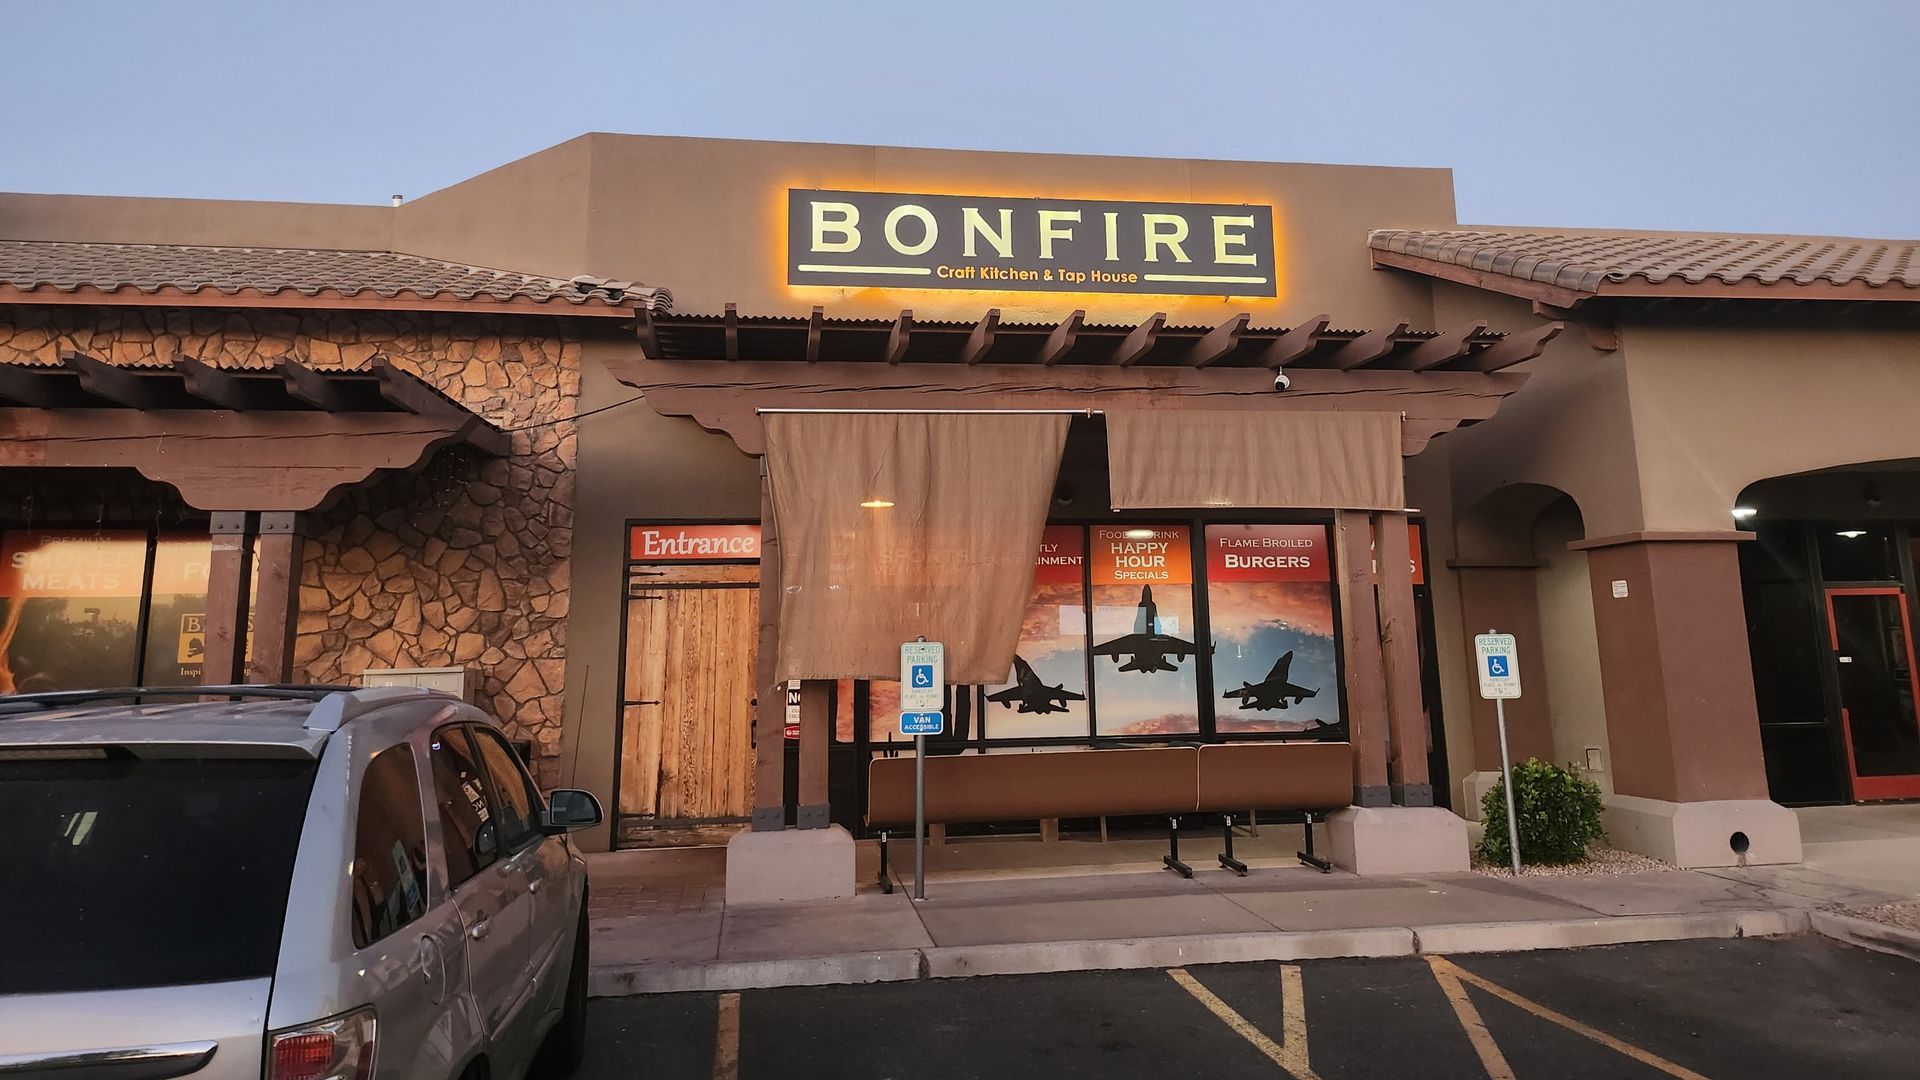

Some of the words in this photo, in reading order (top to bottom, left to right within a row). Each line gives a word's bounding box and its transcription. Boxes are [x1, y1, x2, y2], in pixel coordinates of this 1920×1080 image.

[809, 200, 1258, 267] BONFIRE
[936, 265, 976, 279] Craft
[979, 266, 1039, 281] Kitchen
[1043, 269, 1054, 281] &
[1058, 268, 1087, 284] Tap
[1091, 270, 1138, 283] House
[641, 530, 755, 556] Entrance
[1111, 542, 1169, 554] HAPPY
[1219, 537, 1260, 548] FLAME
[1262, 537, 1313, 548] BROILED
[10, 550, 133, 569] SMOKED
[1035, 556, 1085, 566] INMENT
[1115, 555, 1166, 568] HOUR
[1224, 553, 1311, 569] BURGERS
[1114, 570, 1169, 580] SPECIALS
[21, 572, 120, 591] MEATS
[1479, 638, 1512, 646] RESERVED
[904, 646, 940, 654] RESERVED
[1482, 646, 1511, 654] PARKING
[907, 655, 938, 663] PARKING
[913, 716, 931, 724] VAN
